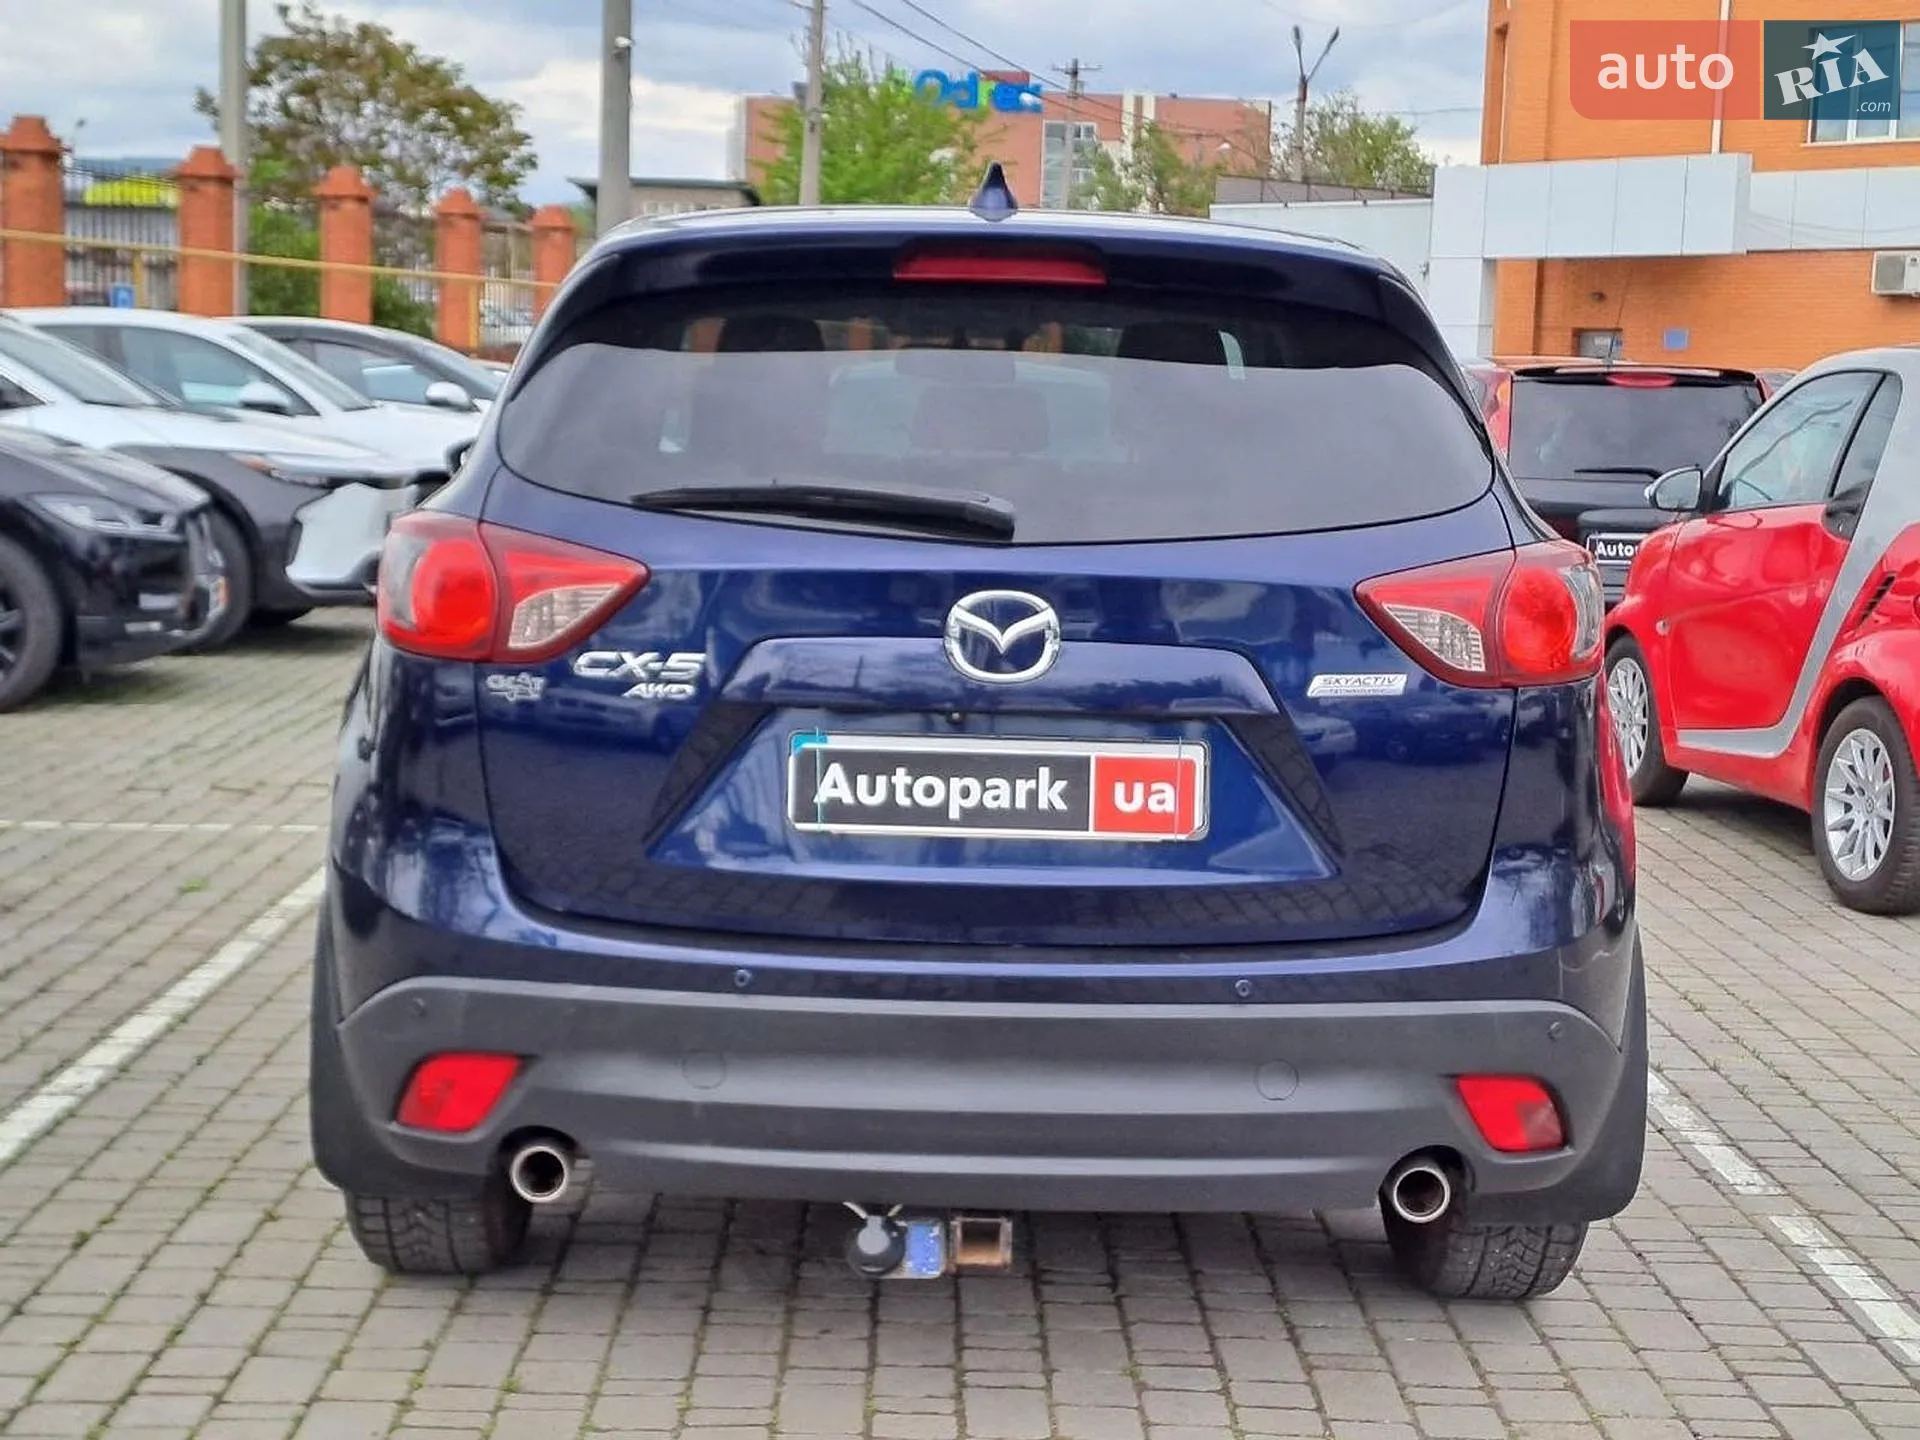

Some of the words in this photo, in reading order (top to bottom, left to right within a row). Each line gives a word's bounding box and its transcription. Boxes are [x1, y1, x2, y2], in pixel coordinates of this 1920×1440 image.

[573, 651, 706, 679] CX-5
[621, 682, 695, 699] AWD
[1321, 676, 1397, 685] SKYACTIV
[814, 762, 1068, 819] Autopark
[1113, 782, 1175, 813] ua
